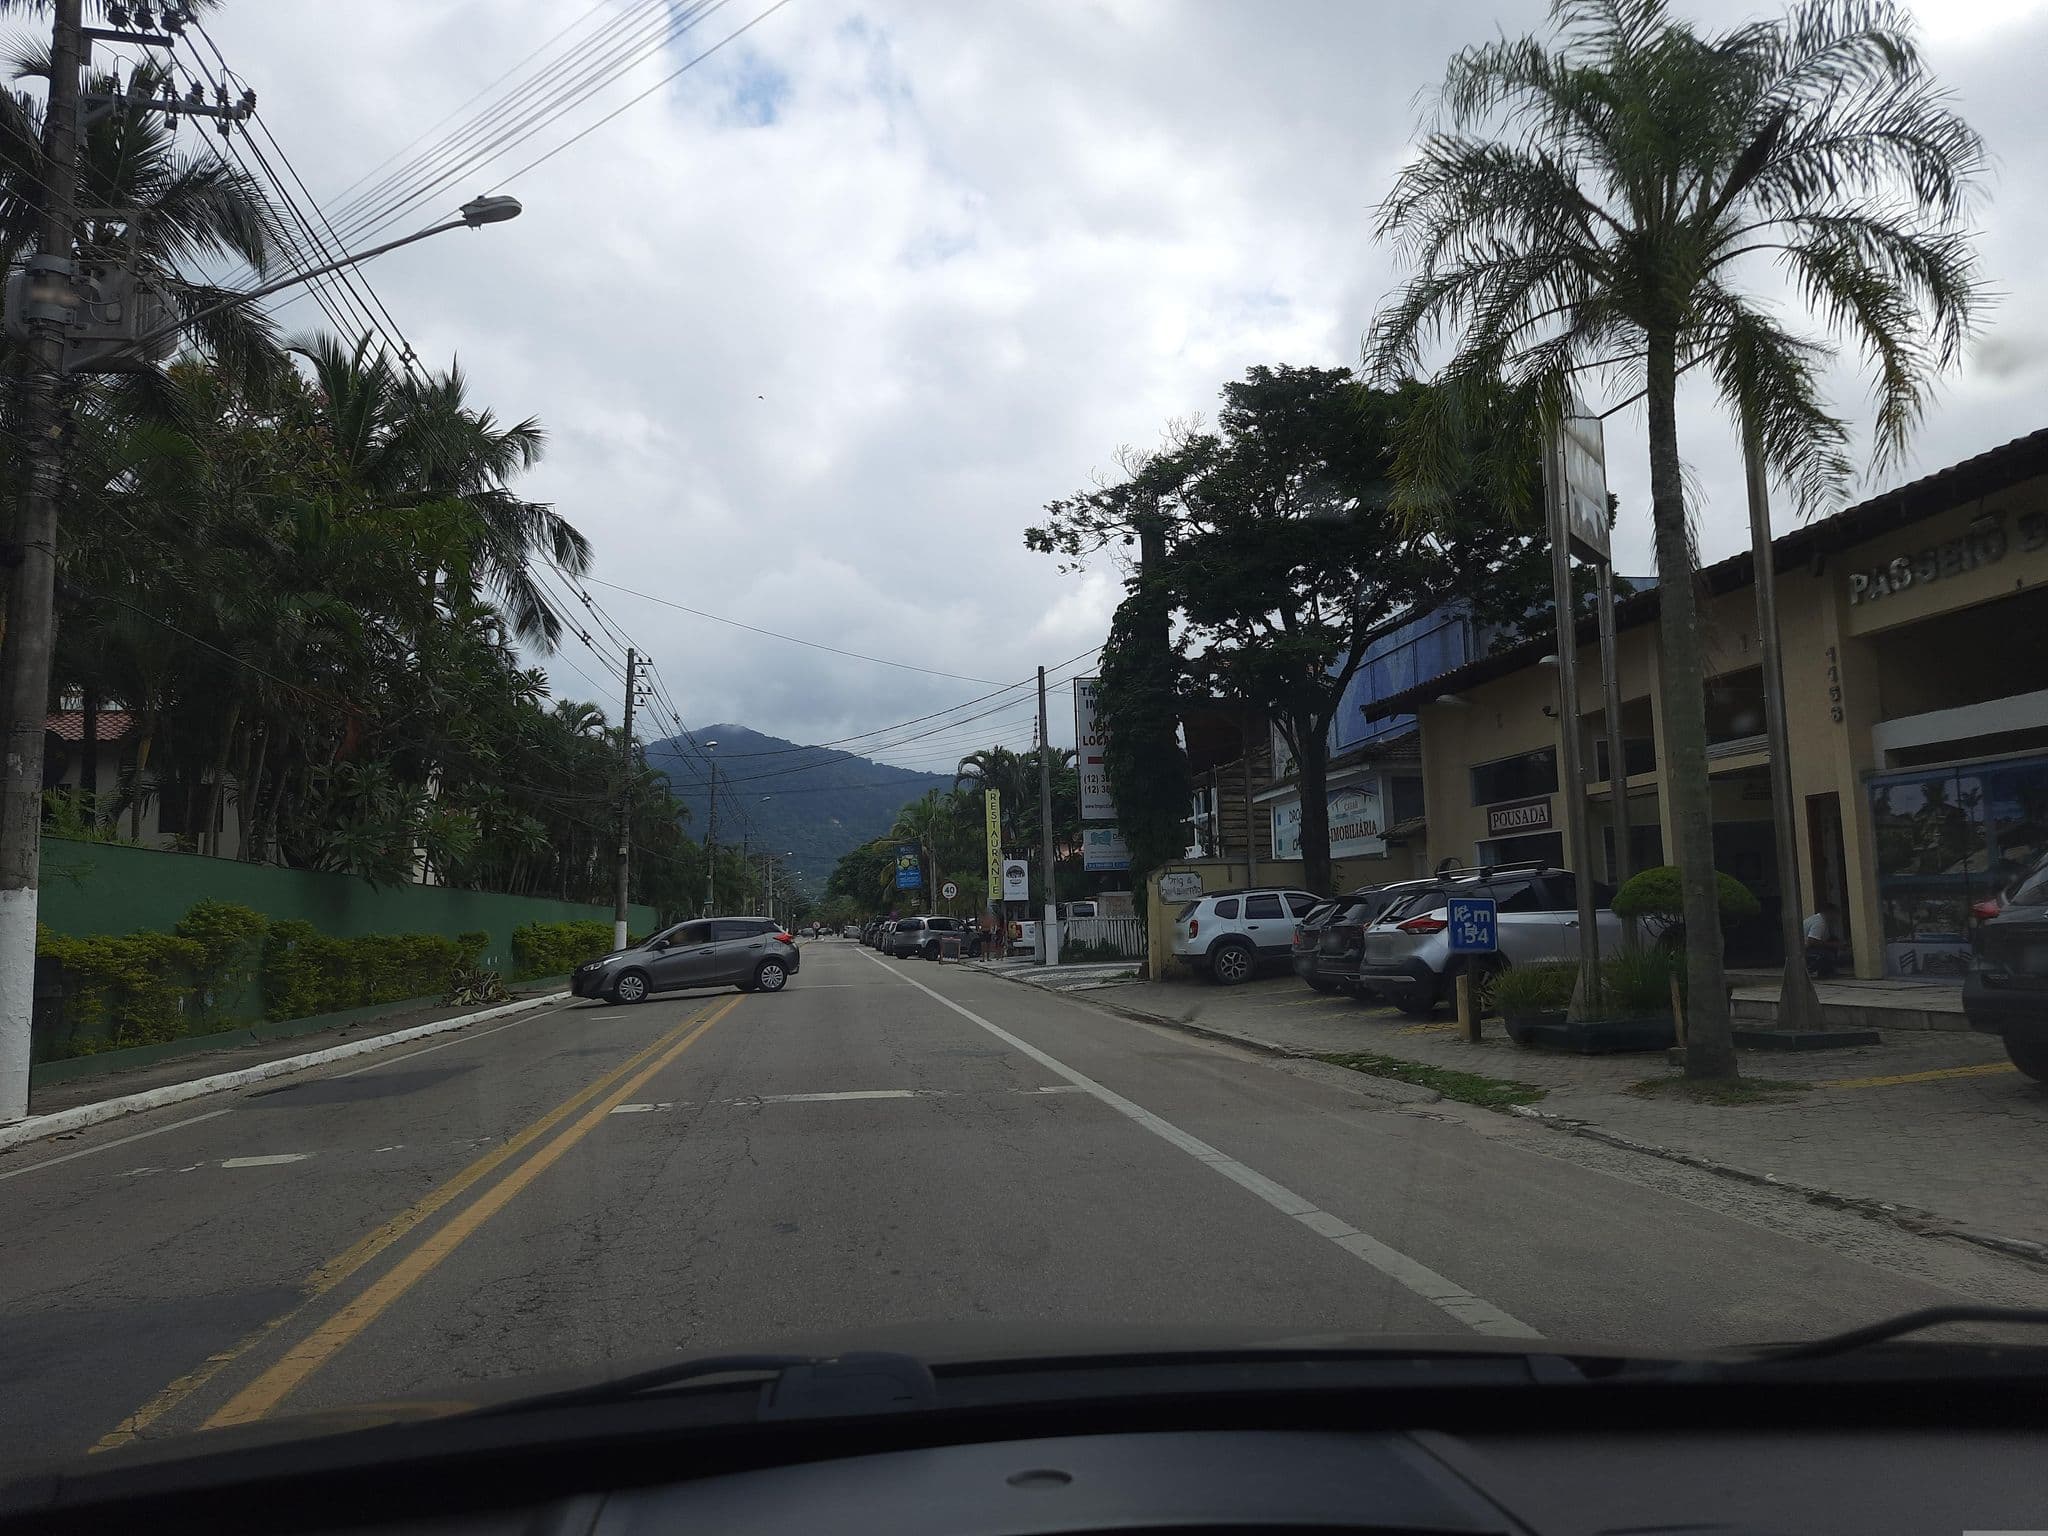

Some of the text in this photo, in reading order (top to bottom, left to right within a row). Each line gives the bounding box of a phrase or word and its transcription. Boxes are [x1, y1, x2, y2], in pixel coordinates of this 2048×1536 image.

[1493, 807, 1546, 828] POUSADA
[1330, 819, 1377, 842] IMOBILIÁRIA
[990, 793, 1000, 895] RESTAURANTE
[944, 886, 955, 894] 40
[1454, 905, 1490, 922] Km
[1457, 926, 1489, 944] 154
